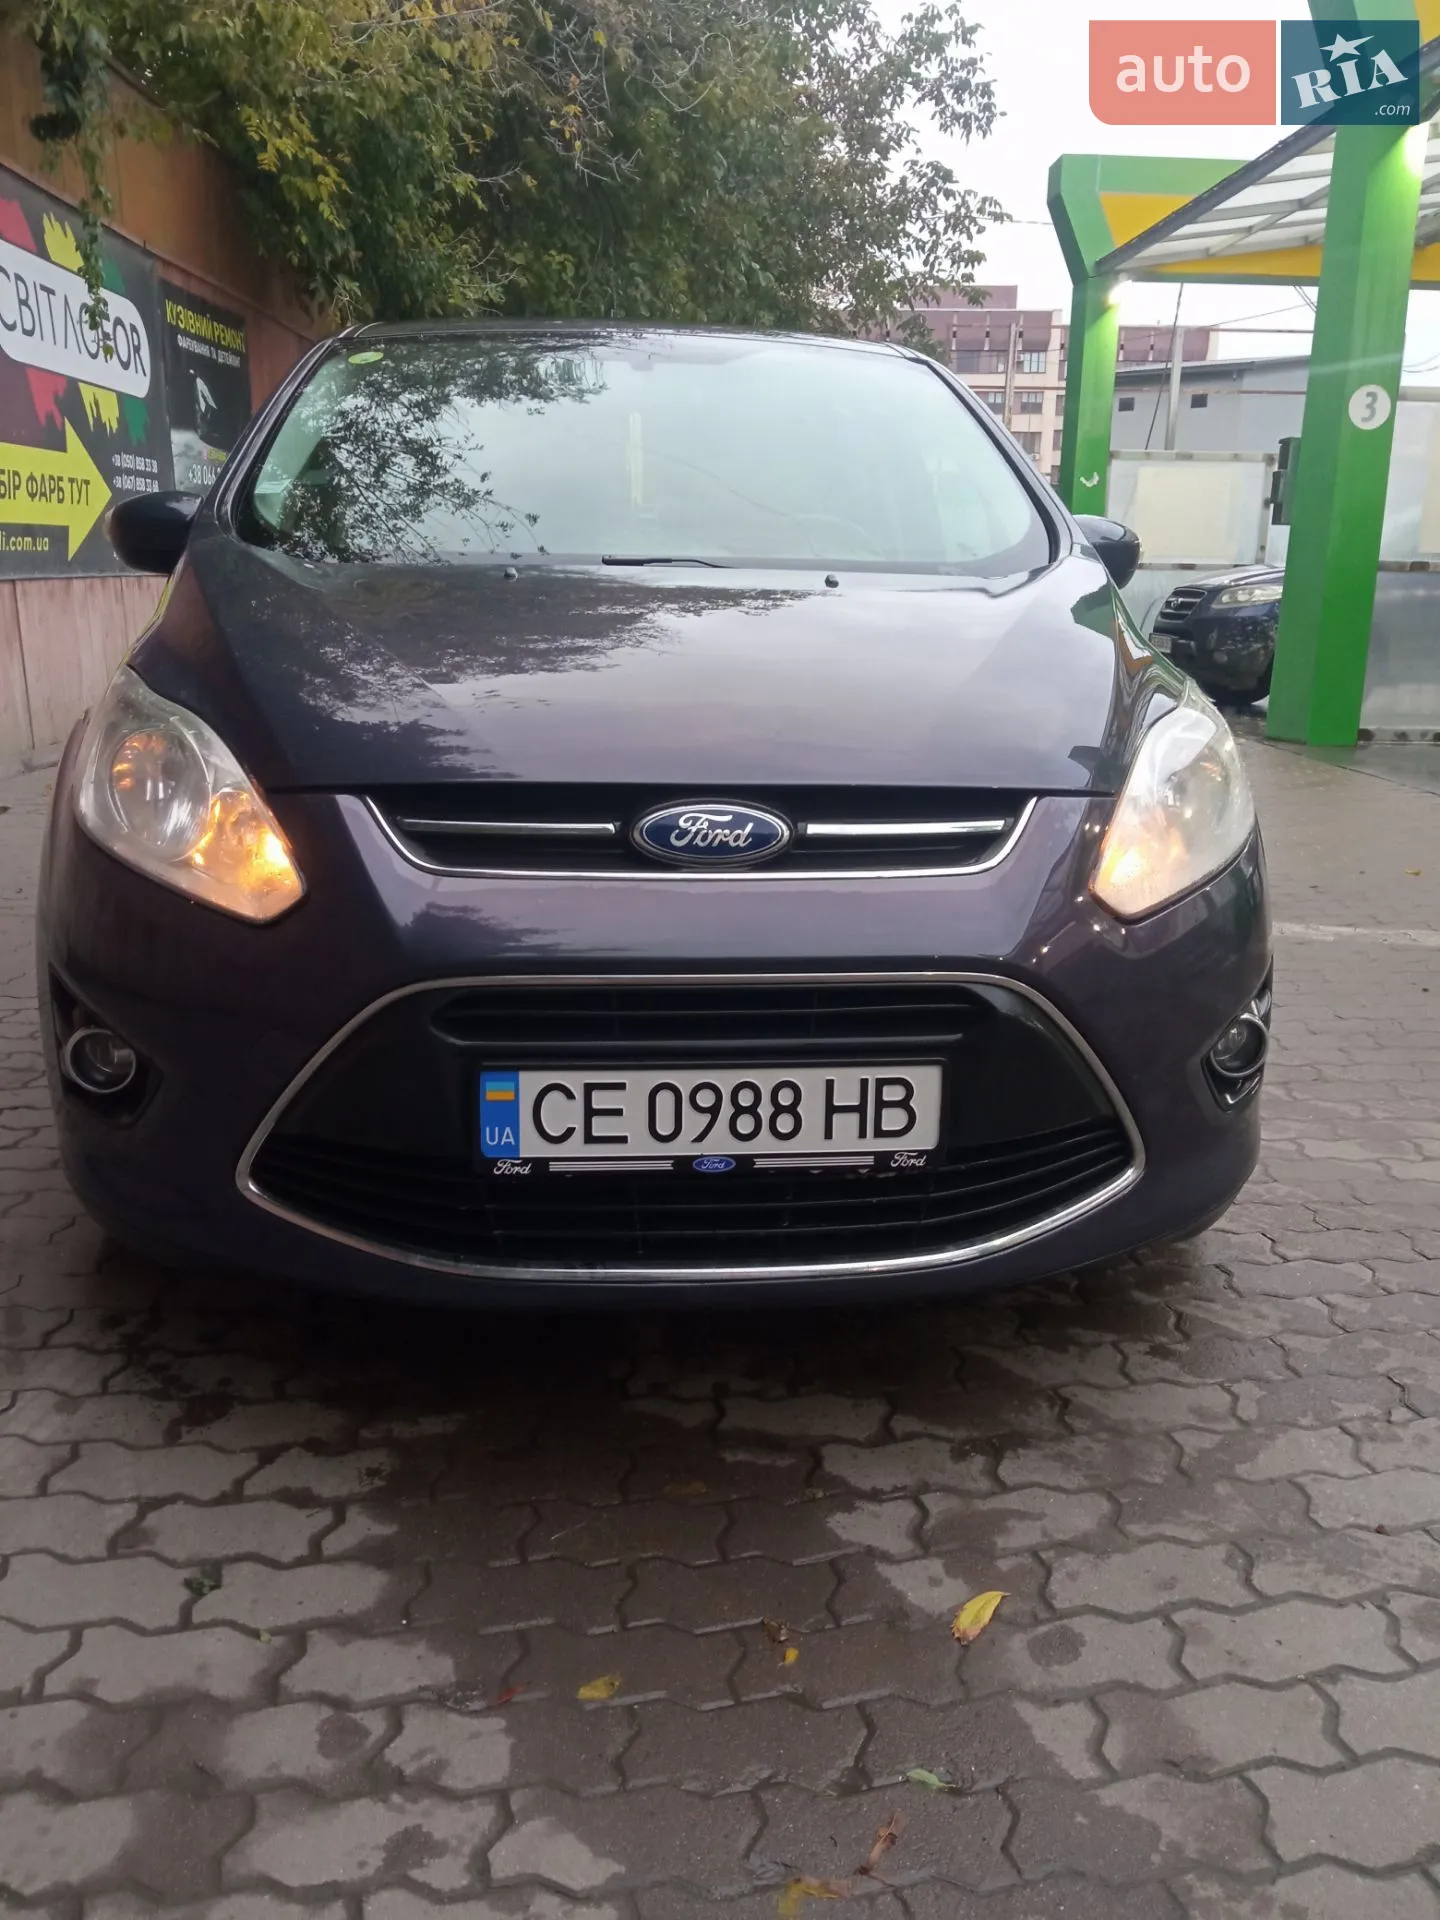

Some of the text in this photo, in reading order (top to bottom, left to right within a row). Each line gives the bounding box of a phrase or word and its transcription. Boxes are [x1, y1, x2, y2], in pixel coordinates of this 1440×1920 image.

[165, 299, 246, 353] КУЗІВНИЙ РЕМОНТ
[1361, 391, 1378, 423] 3
[26, 472, 65, 504] ФАРБ
[68, 477, 91, 507] ТУТ
[188, 463, 202, 485] +38
[670, 812, 754, 847] Ford
[532, 1077, 917, 1145] CE 0988 HB
[485, 1126, 516, 1146] UA
[493, 1151, 927, 1175] Ford Ford Ford
